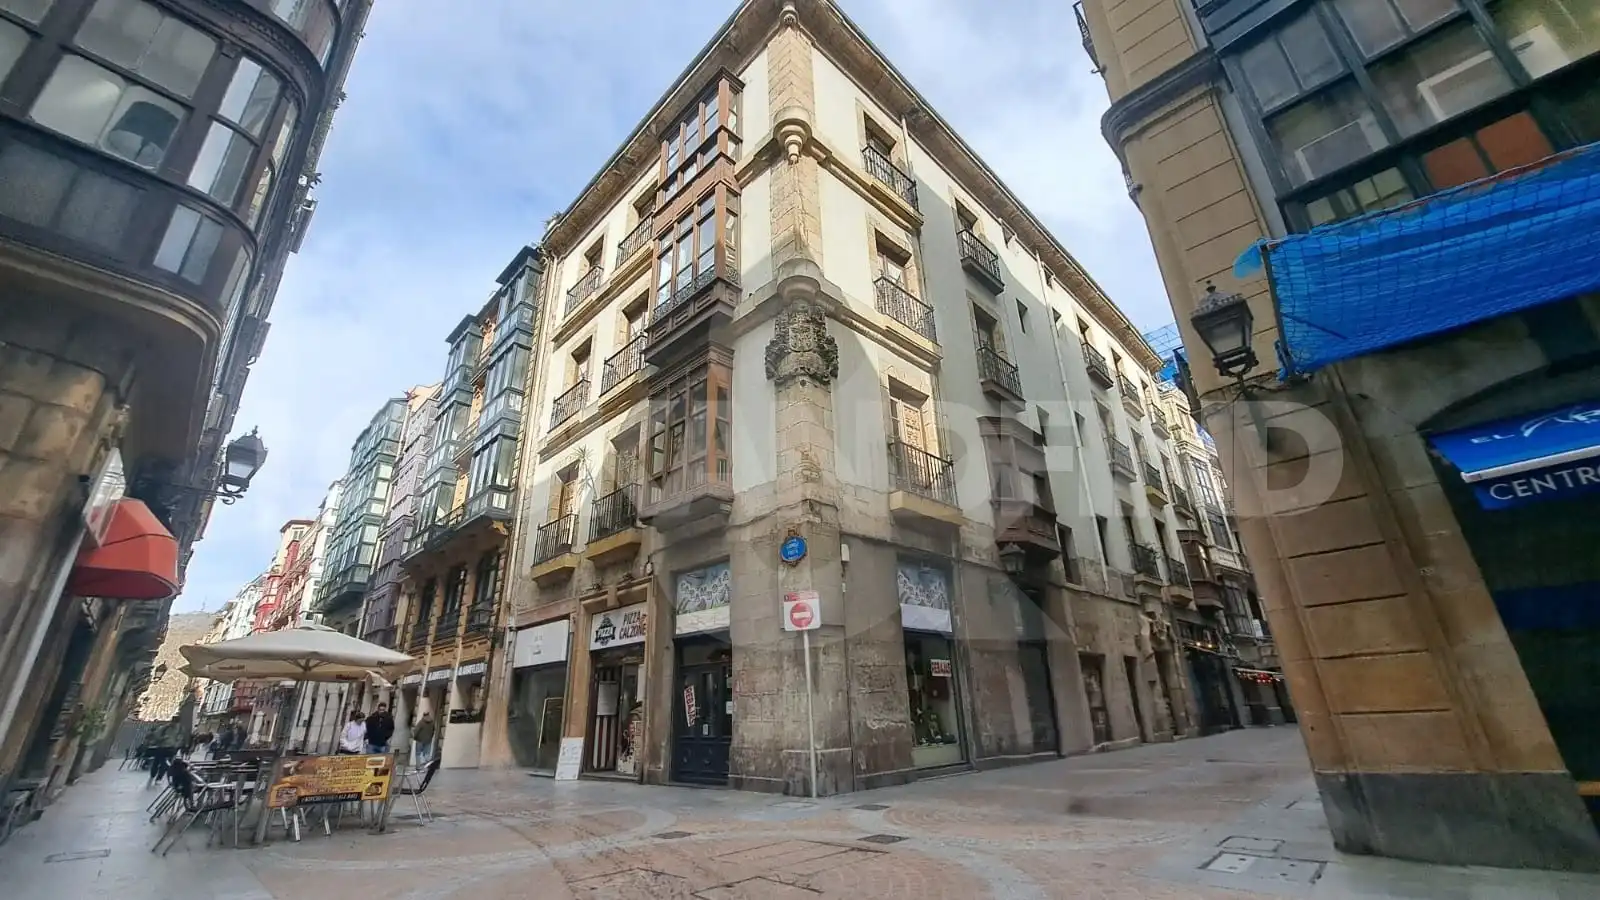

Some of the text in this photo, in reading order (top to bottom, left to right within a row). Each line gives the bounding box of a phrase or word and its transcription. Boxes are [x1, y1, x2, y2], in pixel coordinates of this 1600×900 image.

[1470, 434, 1515, 444] EL
[623, 610, 641, 625] PIZZA
[619, 625, 647, 640] CALZONE
[685, 686, 696, 726] REBAJAS
